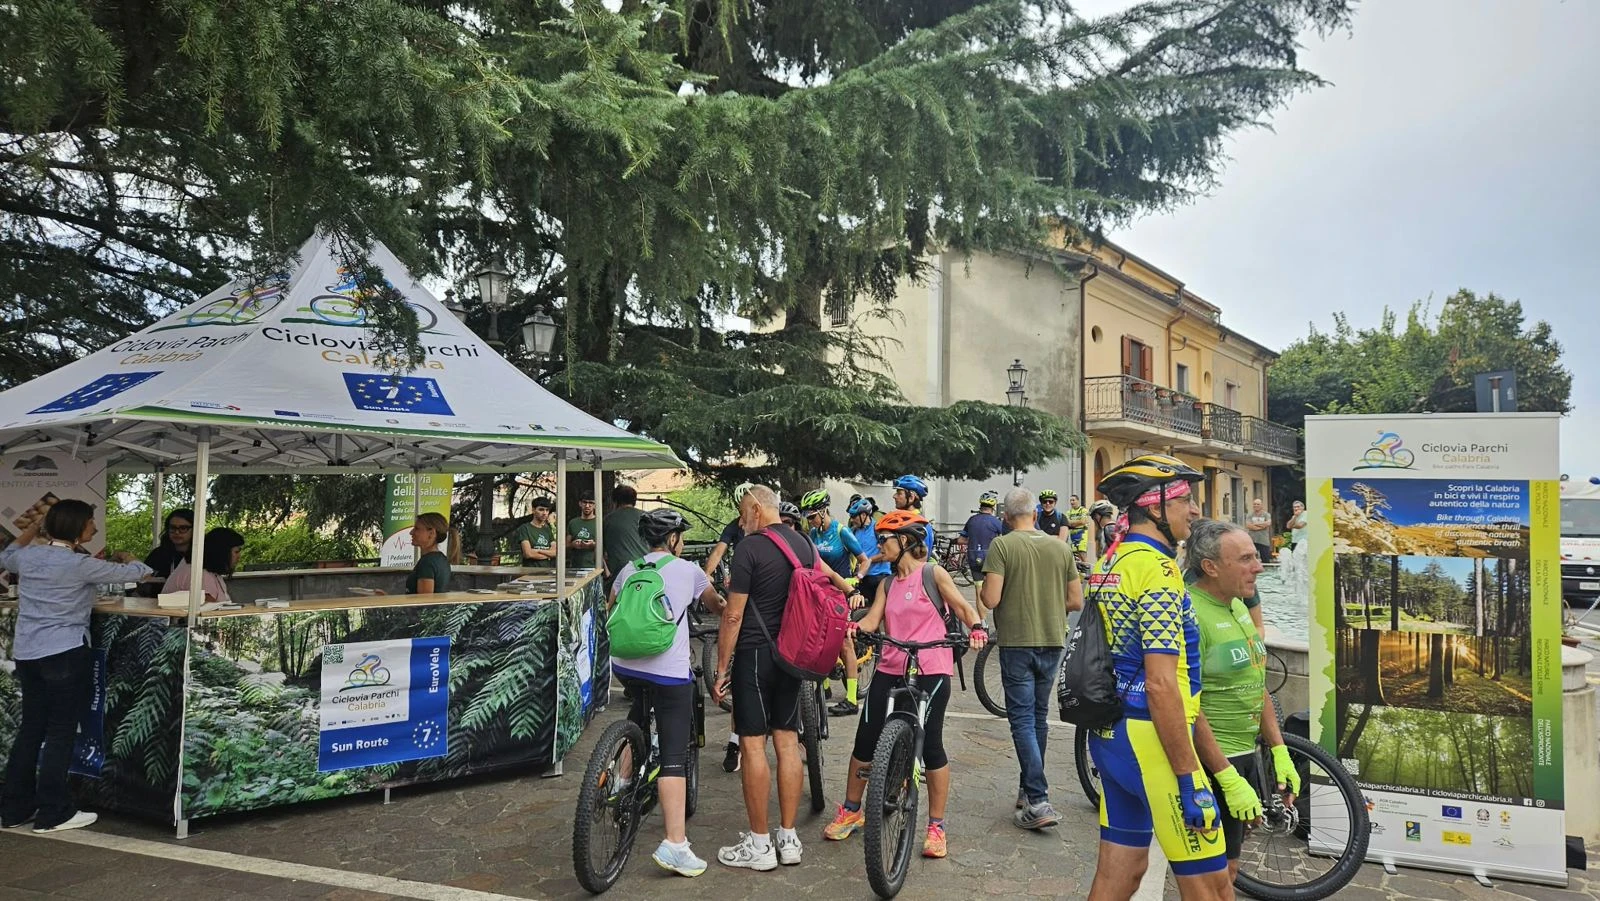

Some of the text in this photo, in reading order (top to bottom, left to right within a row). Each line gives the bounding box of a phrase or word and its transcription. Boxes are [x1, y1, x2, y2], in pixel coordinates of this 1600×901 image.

[110, 329, 253, 353] Ciclovia Parchi
[262, 327, 383, 351] Ciclovia
[120, 348, 203, 365] Calabria
[321, 349, 445, 370] Calbia
[379, 386, 399, 399] 7
[1421, 443, 1508, 453] Ciclovia Parchi
[1441, 453, 1491, 463] Calabria
[393, 486, 448, 496] della salute
[1448, 484, 1474, 493] Scopri
[1485, 484, 1520, 492] Calabria
[1429, 500, 1468, 508] autentico
[1491, 501, 1520, 509] natura
[1489, 493, 1520, 502] respiro
[1436, 513, 1520, 523] Bike through Calabria
[1493, 539, 1520, 547] breath
[429, 647, 440, 694] EuroVelo
[91, 660, 100, 711] EuroVelo
[332, 689, 400, 705] Ciclovia Parchi
[347, 700, 386, 711] Calabria
[422, 728, 432, 743] 7
[331, 737, 389, 753] Sun Route
[86, 746, 96, 760] 7
[1432, 789, 1513, 805] cicloviaparchicalabria.it
